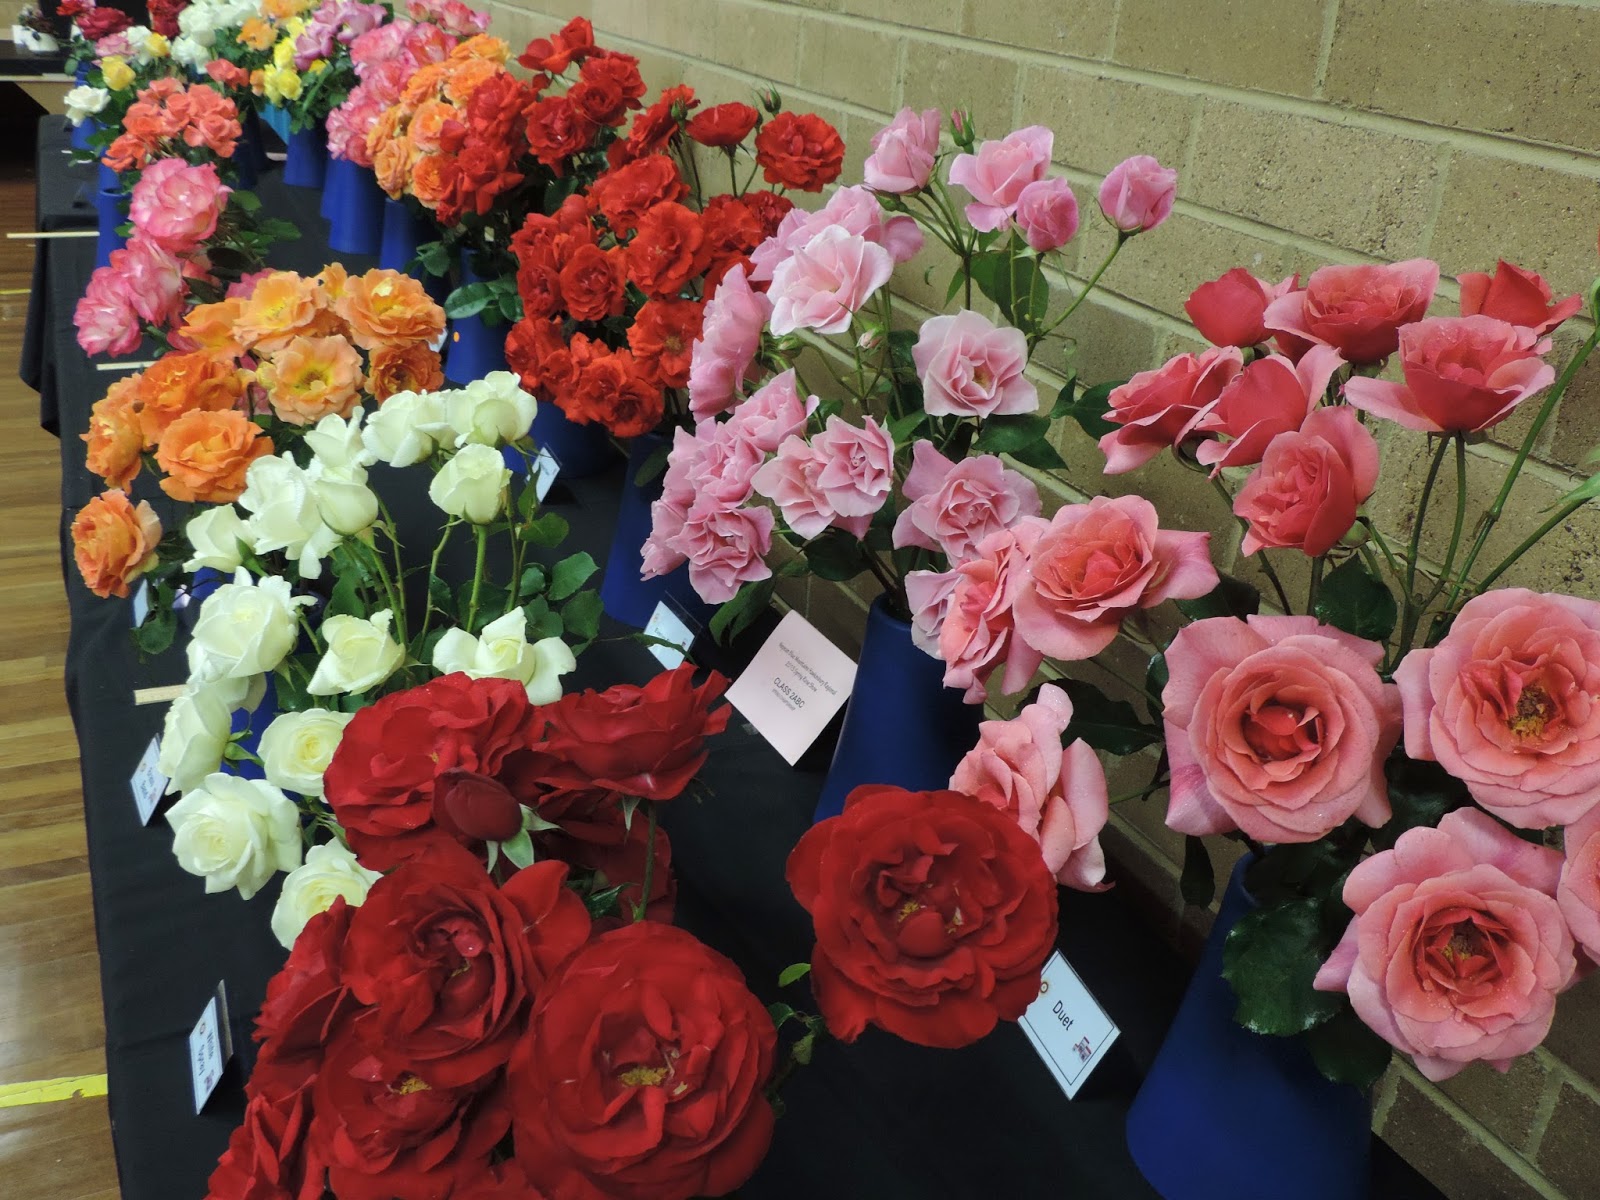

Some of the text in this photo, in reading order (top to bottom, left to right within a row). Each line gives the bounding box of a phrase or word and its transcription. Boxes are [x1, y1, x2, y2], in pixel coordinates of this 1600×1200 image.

[773, 677, 792, 696] CLASS
[788, 691, 806, 709] 2ABC
[1052, 999, 1075, 1031] Duet
